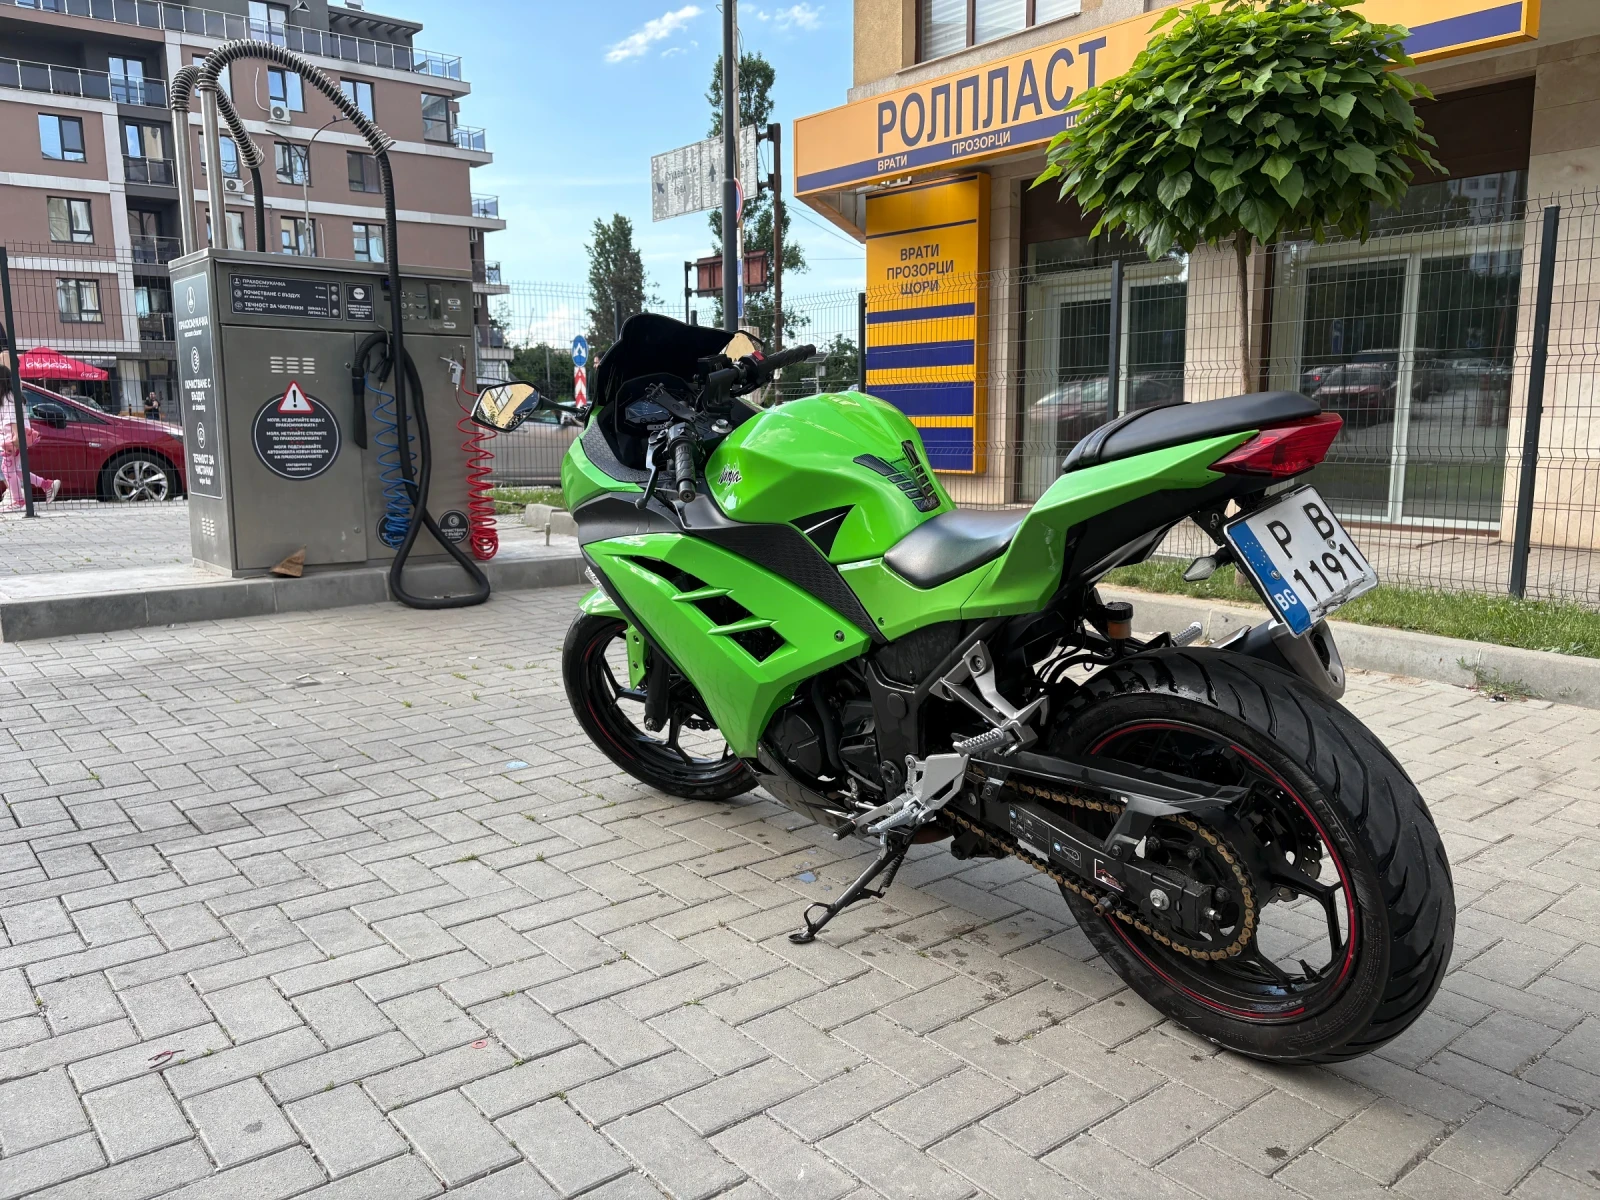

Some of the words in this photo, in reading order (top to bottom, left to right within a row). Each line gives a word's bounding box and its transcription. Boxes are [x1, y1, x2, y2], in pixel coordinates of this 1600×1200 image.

[877, 35, 1107, 154] РОЛПЛАСТ
[877, 154, 908, 172] ВРАТИ
[951, 131, 1011, 156] ПРОЗОРЦИ
[900, 243, 940, 262] ВРАТИ
[886, 259, 954, 280] ПРОЗОРЦИ
[243, 289, 277, 297] ПОЧИСТВАНЕ
[900, 279, 939, 297] ЩОРИ
[277, 303, 304, 311] ЧИСТАЧКИ
[184, 378, 207, 389] ПОЧИСТВАНЕ
[1265, 519, 1293, 559] P
[1302, 501, 1335, 541] B
[1292, 542, 1364, 604] 1191
[1273, 588, 1298, 611] BG
